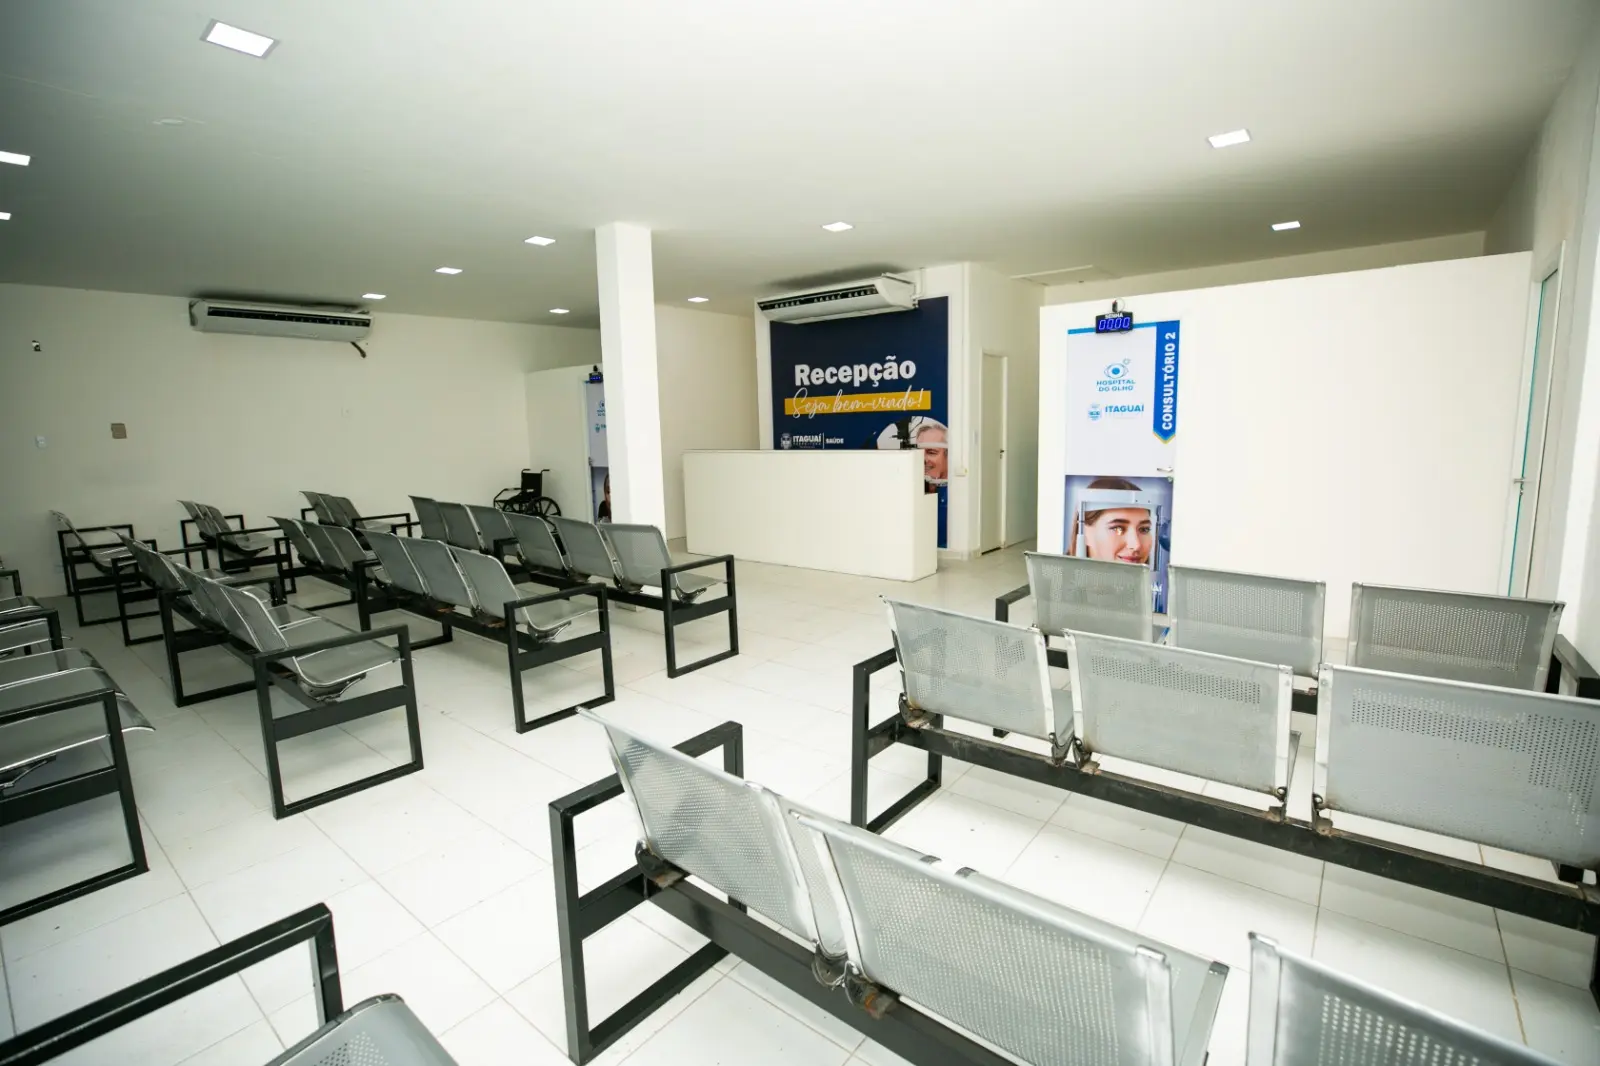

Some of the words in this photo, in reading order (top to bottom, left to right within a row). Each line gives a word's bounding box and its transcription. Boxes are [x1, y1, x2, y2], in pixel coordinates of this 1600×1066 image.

[1099, 317, 1131, 330] 0000
[1165, 331, 1176, 340] 2
[794, 355, 917, 388] Recepção
[1161, 343, 1176, 430] CONSULTÓRIO
[792, 387, 829, 419] Seja
[832, 385, 924, 413] bem-vindo!
[793, 433, 822, 443] ITAGUAÍ
